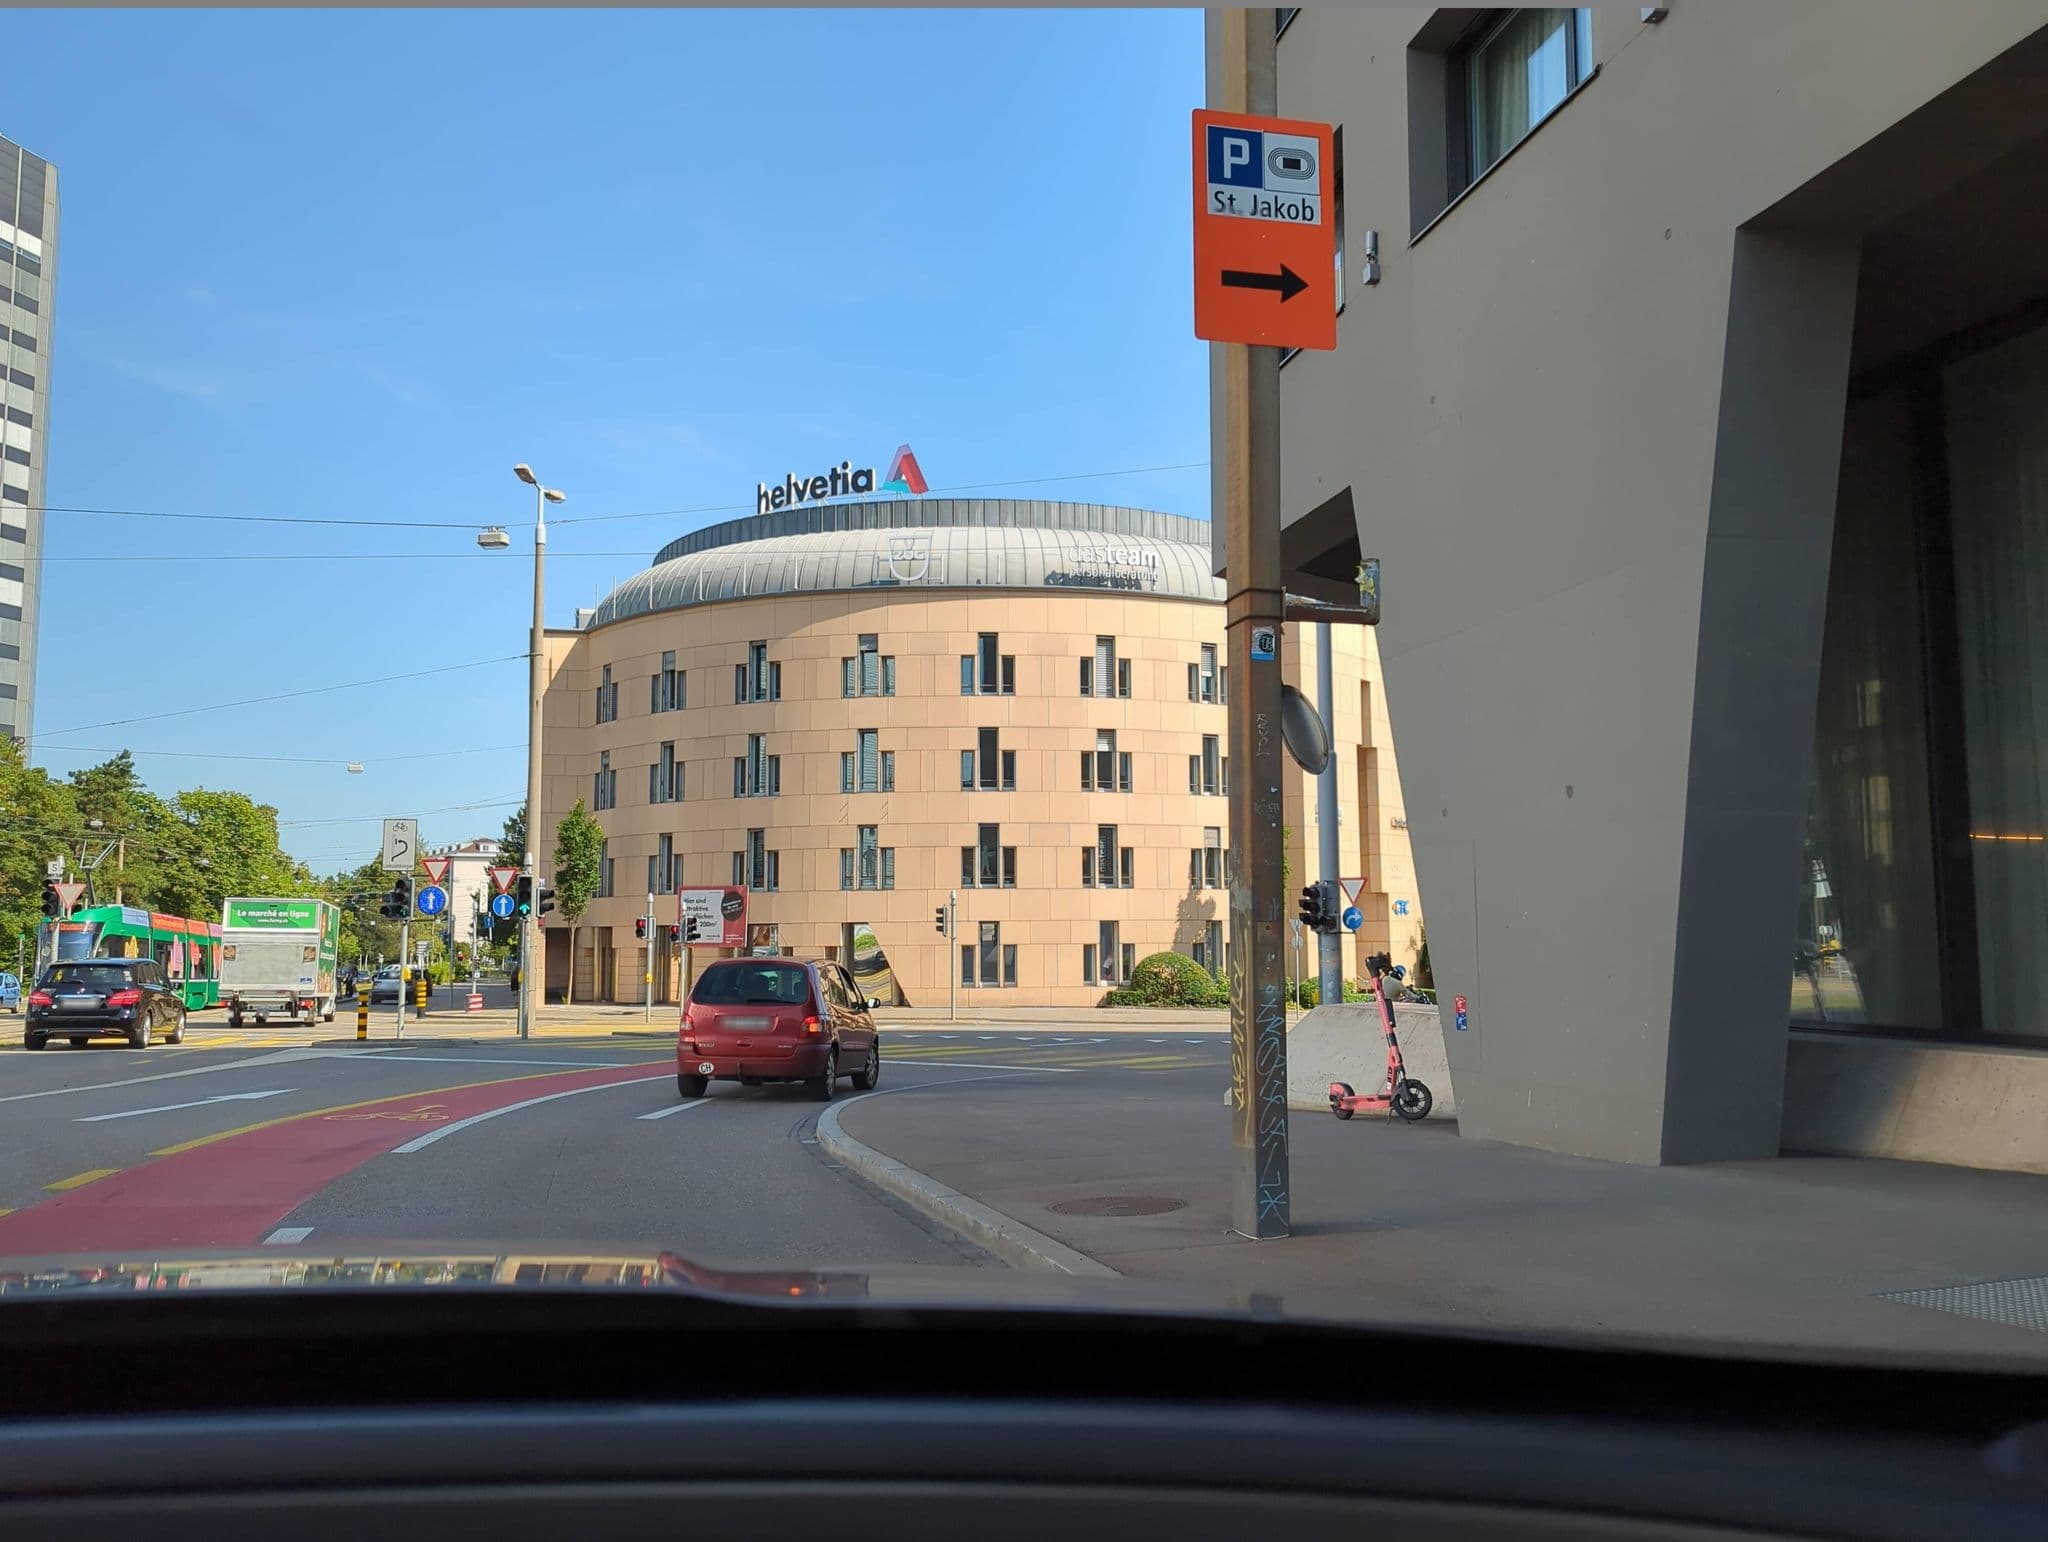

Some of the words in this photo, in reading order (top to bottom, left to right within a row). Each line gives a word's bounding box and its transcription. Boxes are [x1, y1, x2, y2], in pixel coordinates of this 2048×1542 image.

[1223, 136, 1250, 180] P
[1250, 194, 1315, 222] Jakob
[757, 460, 876, 515] helvetia
[238, 909, 247, 917] Le
[248, 909, 278, 917] marché
[290, 910, 309, 918] ligne
[700, 1062, 713, 1073] CH
